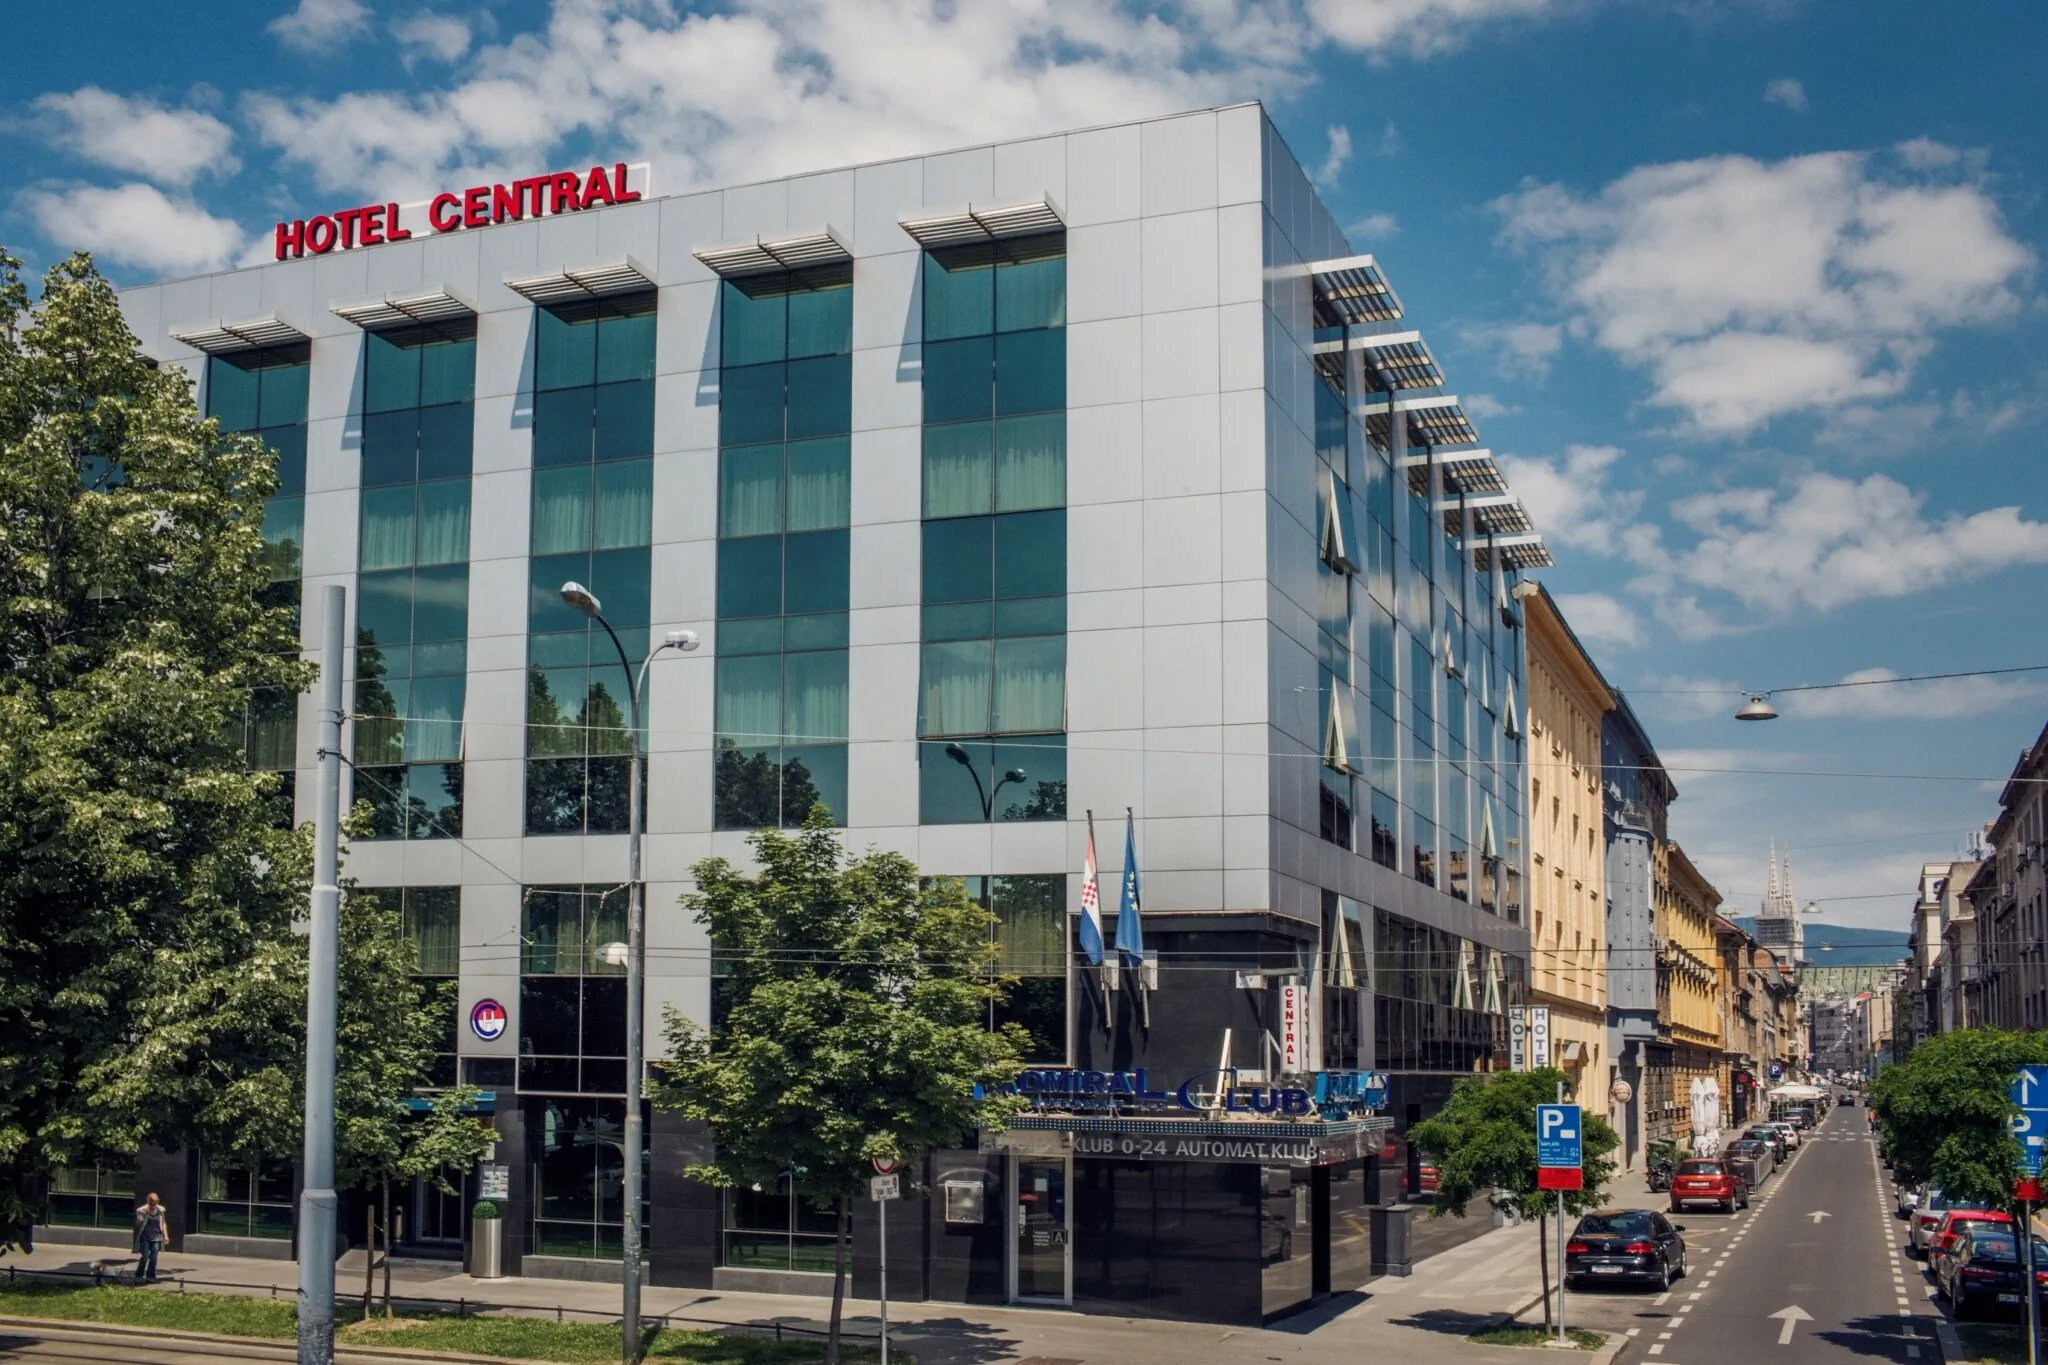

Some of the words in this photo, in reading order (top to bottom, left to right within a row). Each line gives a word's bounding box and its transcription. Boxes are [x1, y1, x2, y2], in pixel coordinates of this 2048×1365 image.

[275, 202, 411, 261] HOTEL
[429, 162, 641, 232] CENTRAL
[1285, 988, 1294, 1065] CENTRAL
[1535, 1010, 1546, 1064] HOTE
[1177, 1066, 1311, 1115] CLUB
[1122, 1139, 1167, 1155] 0-24
[1271, 1143, 1318, 1160] KLUB
[1543, 1110, 1563, 1138] P
